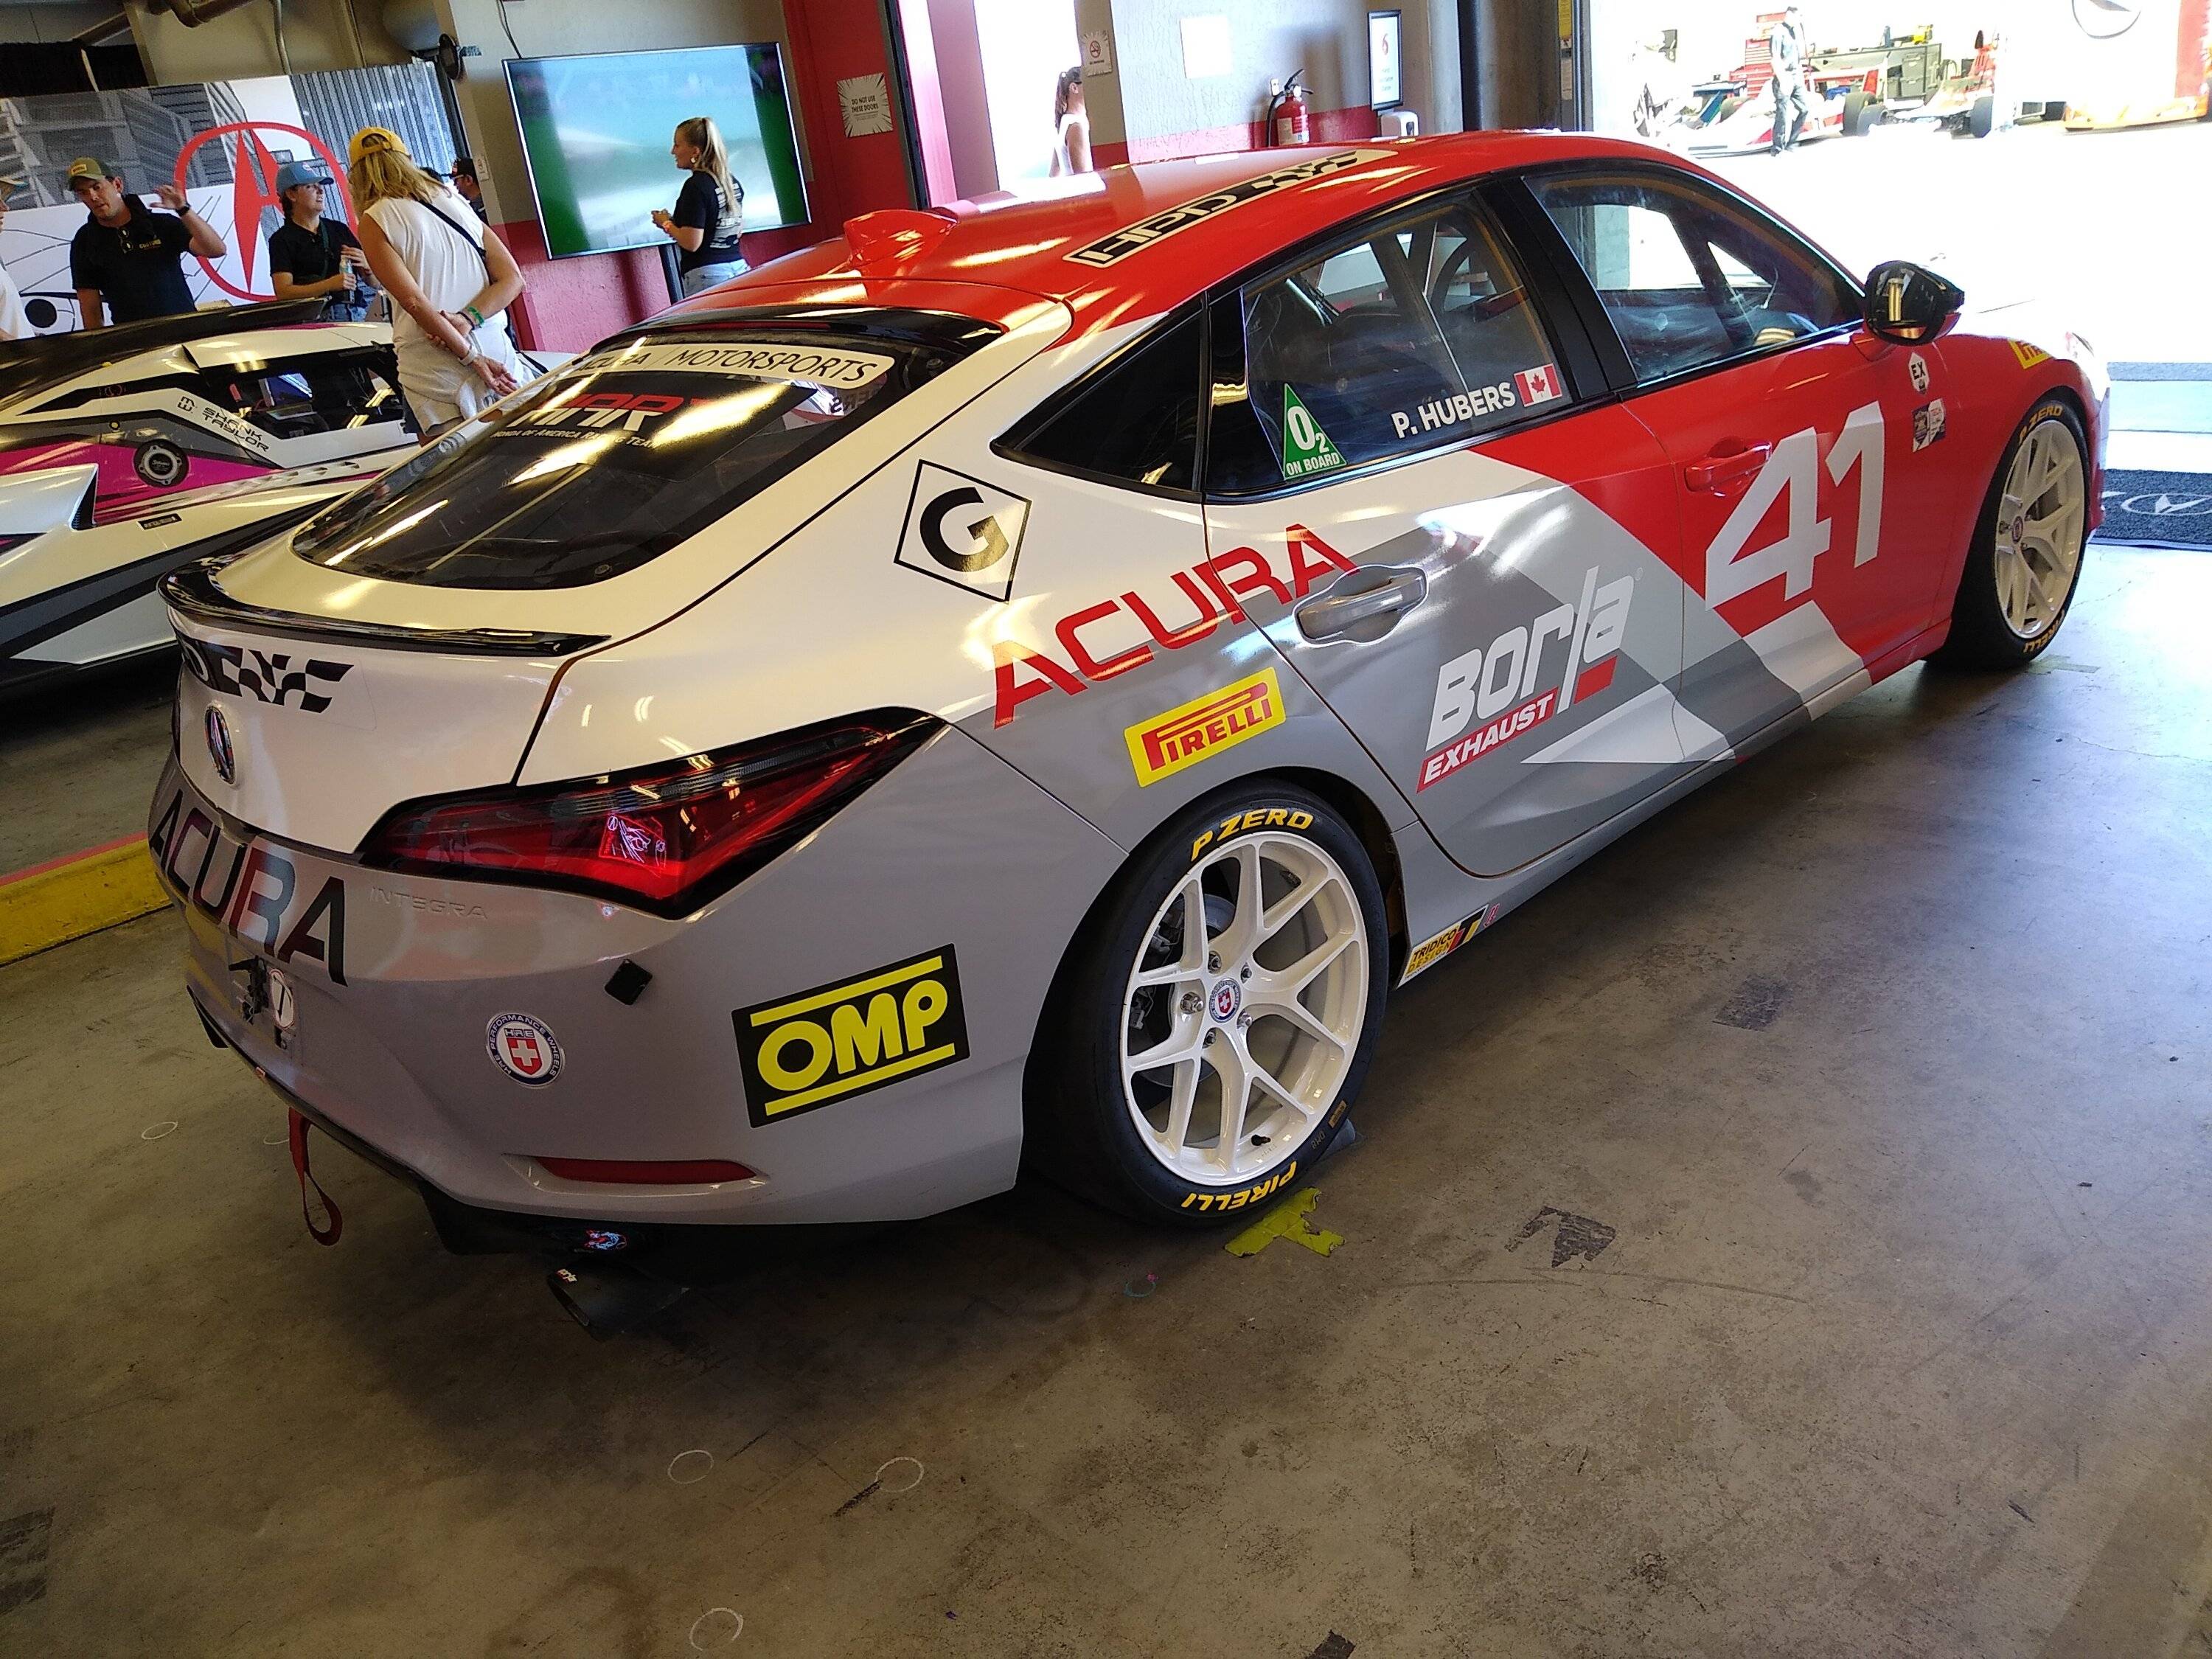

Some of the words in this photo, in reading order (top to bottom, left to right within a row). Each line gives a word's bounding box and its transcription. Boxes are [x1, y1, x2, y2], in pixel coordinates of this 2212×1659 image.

[1078, 195, 1238, 262] HPD
[664, 349, 877, 382] MOTORSPORTS
[1910, 361, 1926, 380] EX
[202, 407, 263, 442] SHANK
[202, 412, 270, 452] TAYLOR
[535, 429, 582, 438] AMERICA
[580, 431, 626, 443] RAG
[1391, 411, 1419, 439] P.
[1416, 381, 1516, 431] HUBERS
[2028, 405, 2063, 426] ZERO
[1286, 461, 1303, 476] ON
[1304, 453, 1340, 473] BOARD
[919, 486, 1009, 573] G
[1705, 400, 1885, 611] 41
[993, 523, 1360, 730] ACURA
[1141, 681, 1273, 772] PIRELLI
[1424, 692, 1555, 785] EXHAUST
[1191, 830, 1214, 863] P
[1217, 807, 1314, 841] ZERO
[150, 788, 349, 988] ACURA
[369, 886, 488, 920] INTEGRA
[1413, 928, 1458, 962] TRIDICO
[490, 1014, 546, 1051] PERFORMANCE
[546, 1036, 560, 1077] WHEELS
[504, 1028, 535, 1038] HRE
[757, 978, 949, 1092] OMP
[1180, 1160, 1298, 1211] PIRELLI
